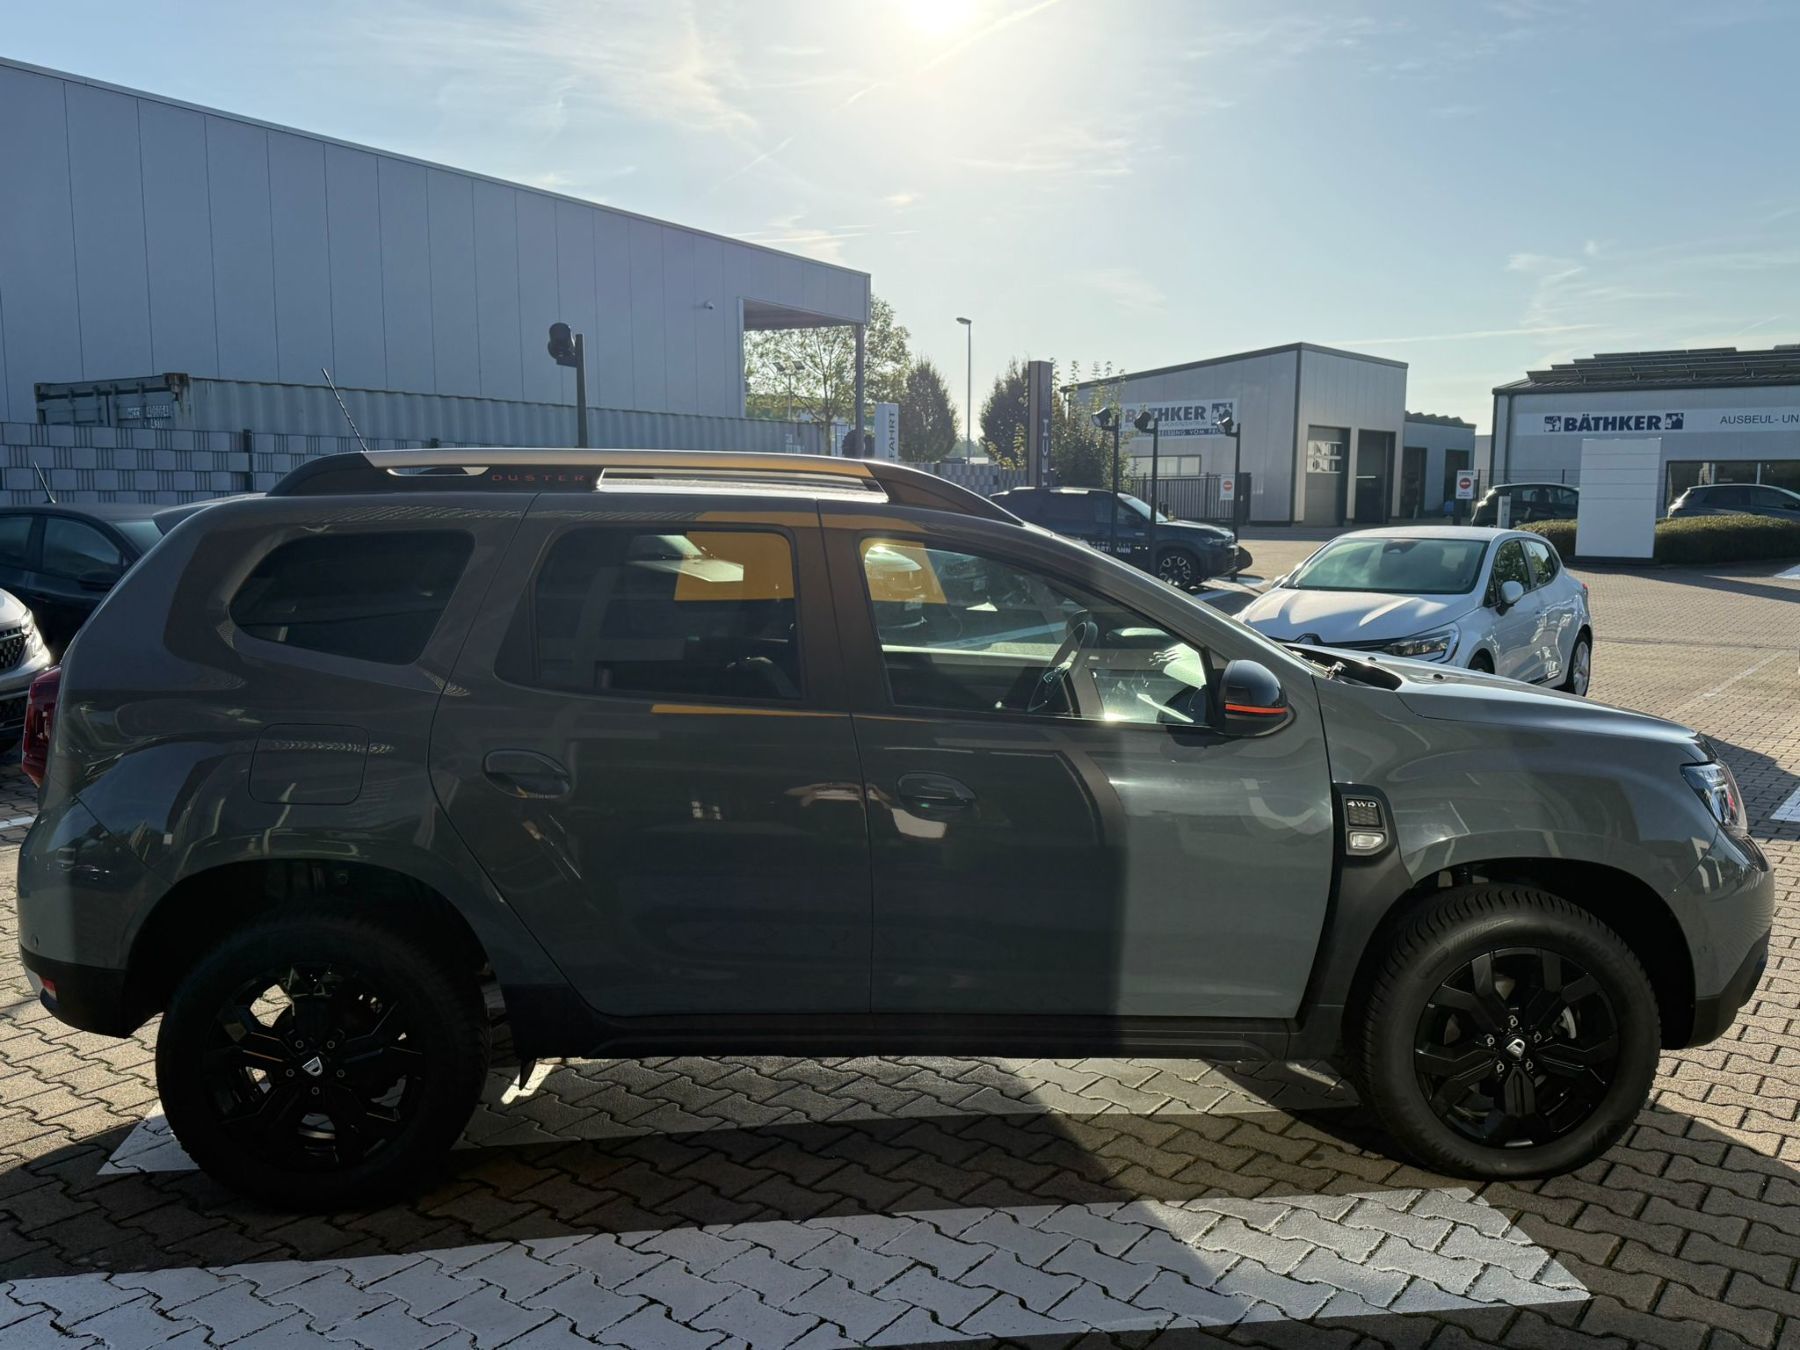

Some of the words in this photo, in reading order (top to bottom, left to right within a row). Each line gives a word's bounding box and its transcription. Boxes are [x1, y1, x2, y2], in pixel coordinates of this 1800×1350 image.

[1124, 406, 1206, 423] BTHKER
[1563, 413, 1662, 432] BÄTHKER
[1720, 415, 1779, 425] AUSBEUL-
